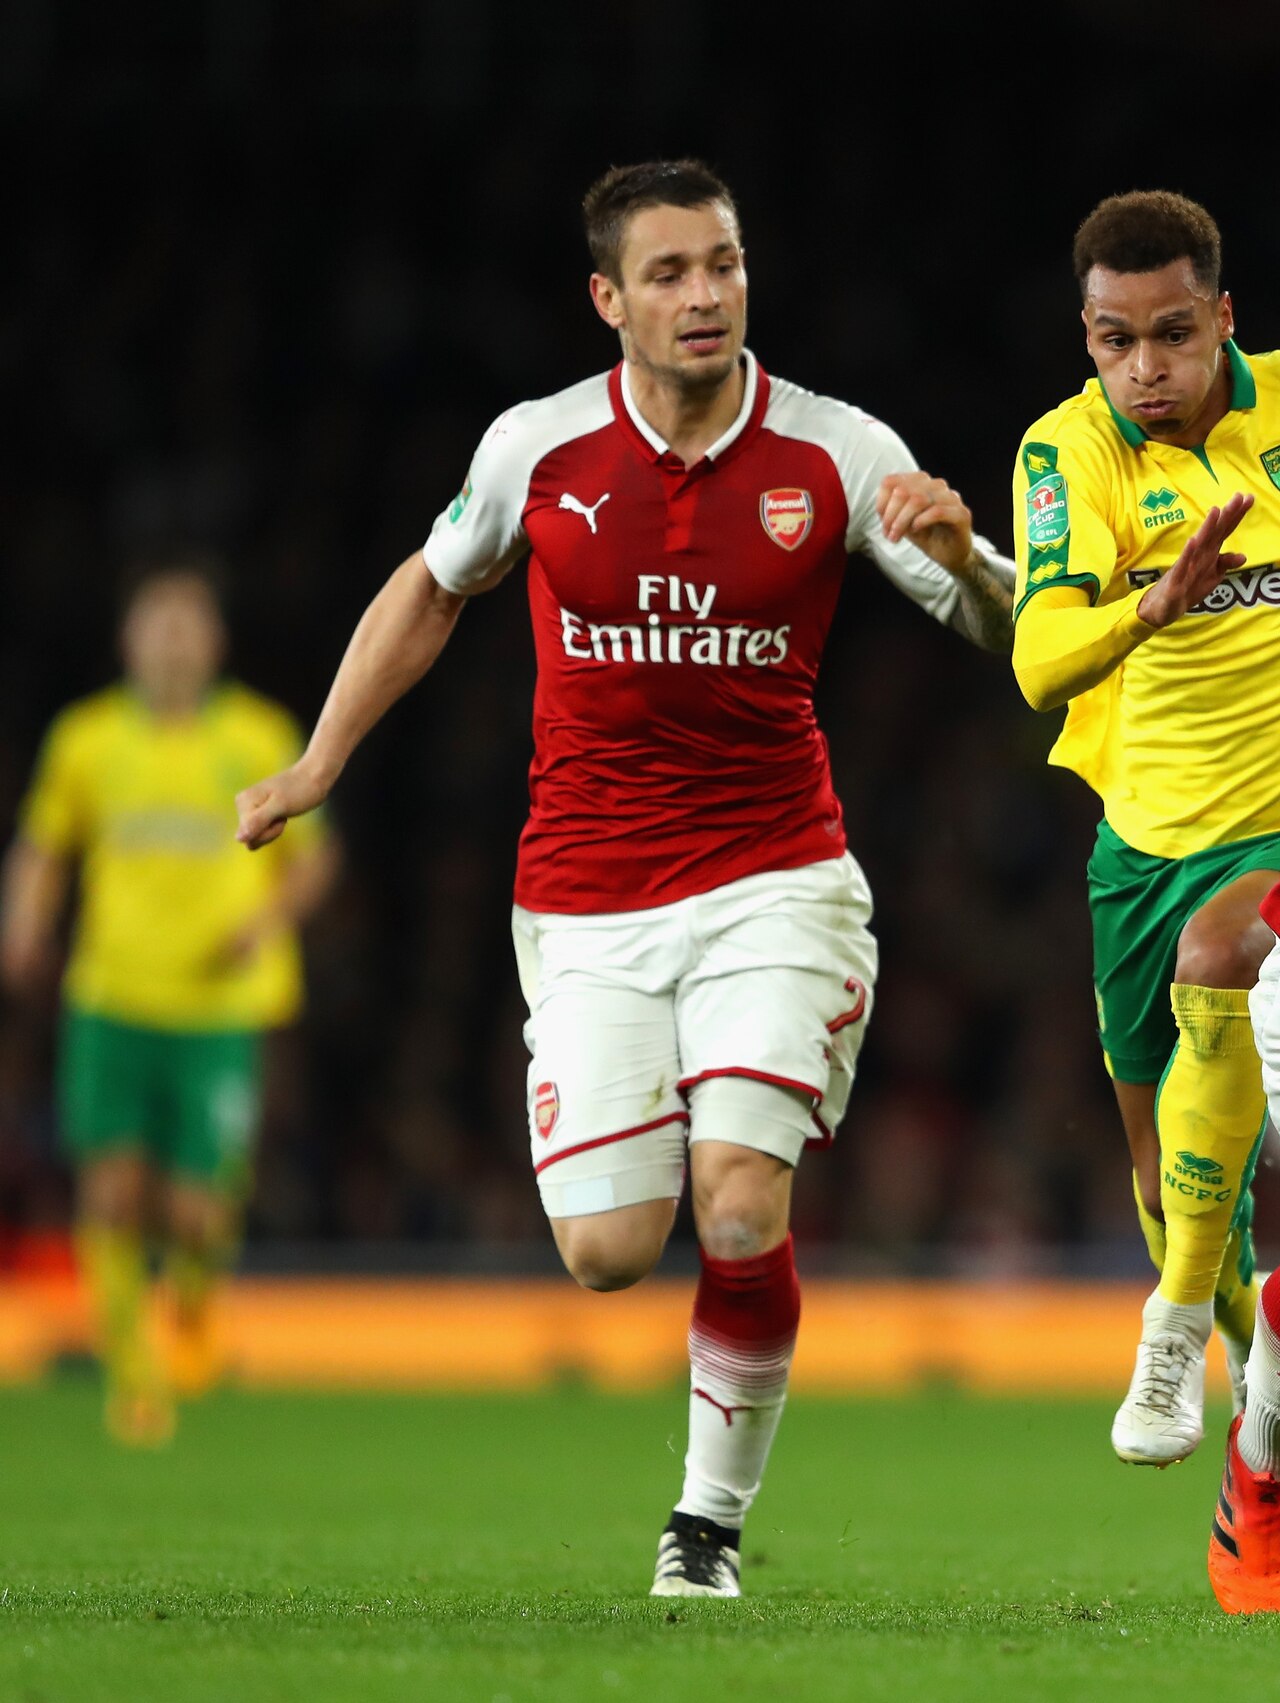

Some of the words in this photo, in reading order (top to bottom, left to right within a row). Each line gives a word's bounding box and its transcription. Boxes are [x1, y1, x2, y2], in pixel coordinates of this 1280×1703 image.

[1035, 512, 1055, 527] Cup
[1144, 508, 1185, 528] errea
[638, 574, 717, 620] Fly
[560, 607, 790, 666] Emirates
